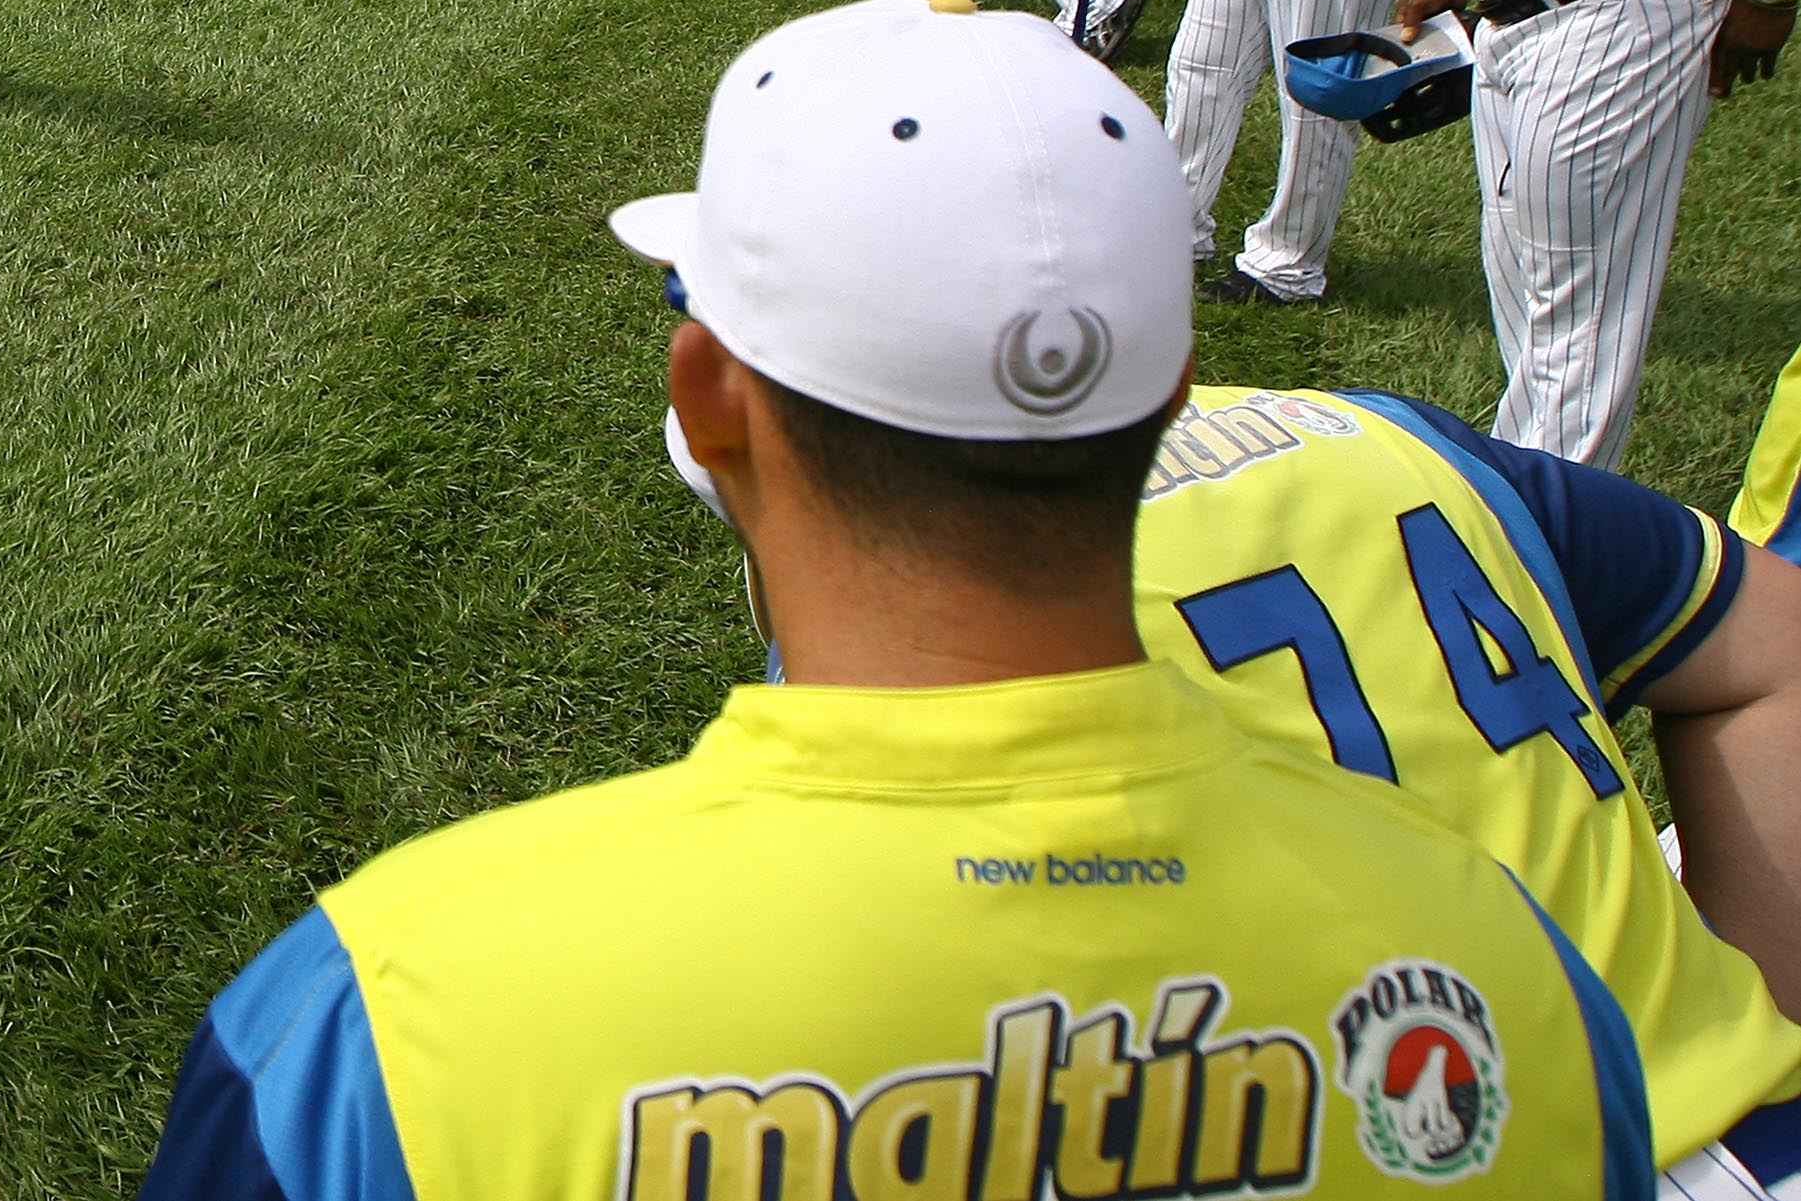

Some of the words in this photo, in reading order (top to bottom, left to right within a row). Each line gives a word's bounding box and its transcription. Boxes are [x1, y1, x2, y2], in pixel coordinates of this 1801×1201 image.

[1175, 501, 1625, 801] 74
[956, 852, 1035, 885] new
[1046, 852, 1187, 887] balance
[619, 977, 1321, 1201] maltín
[1337, 963, 1497, 1070] POLAR
